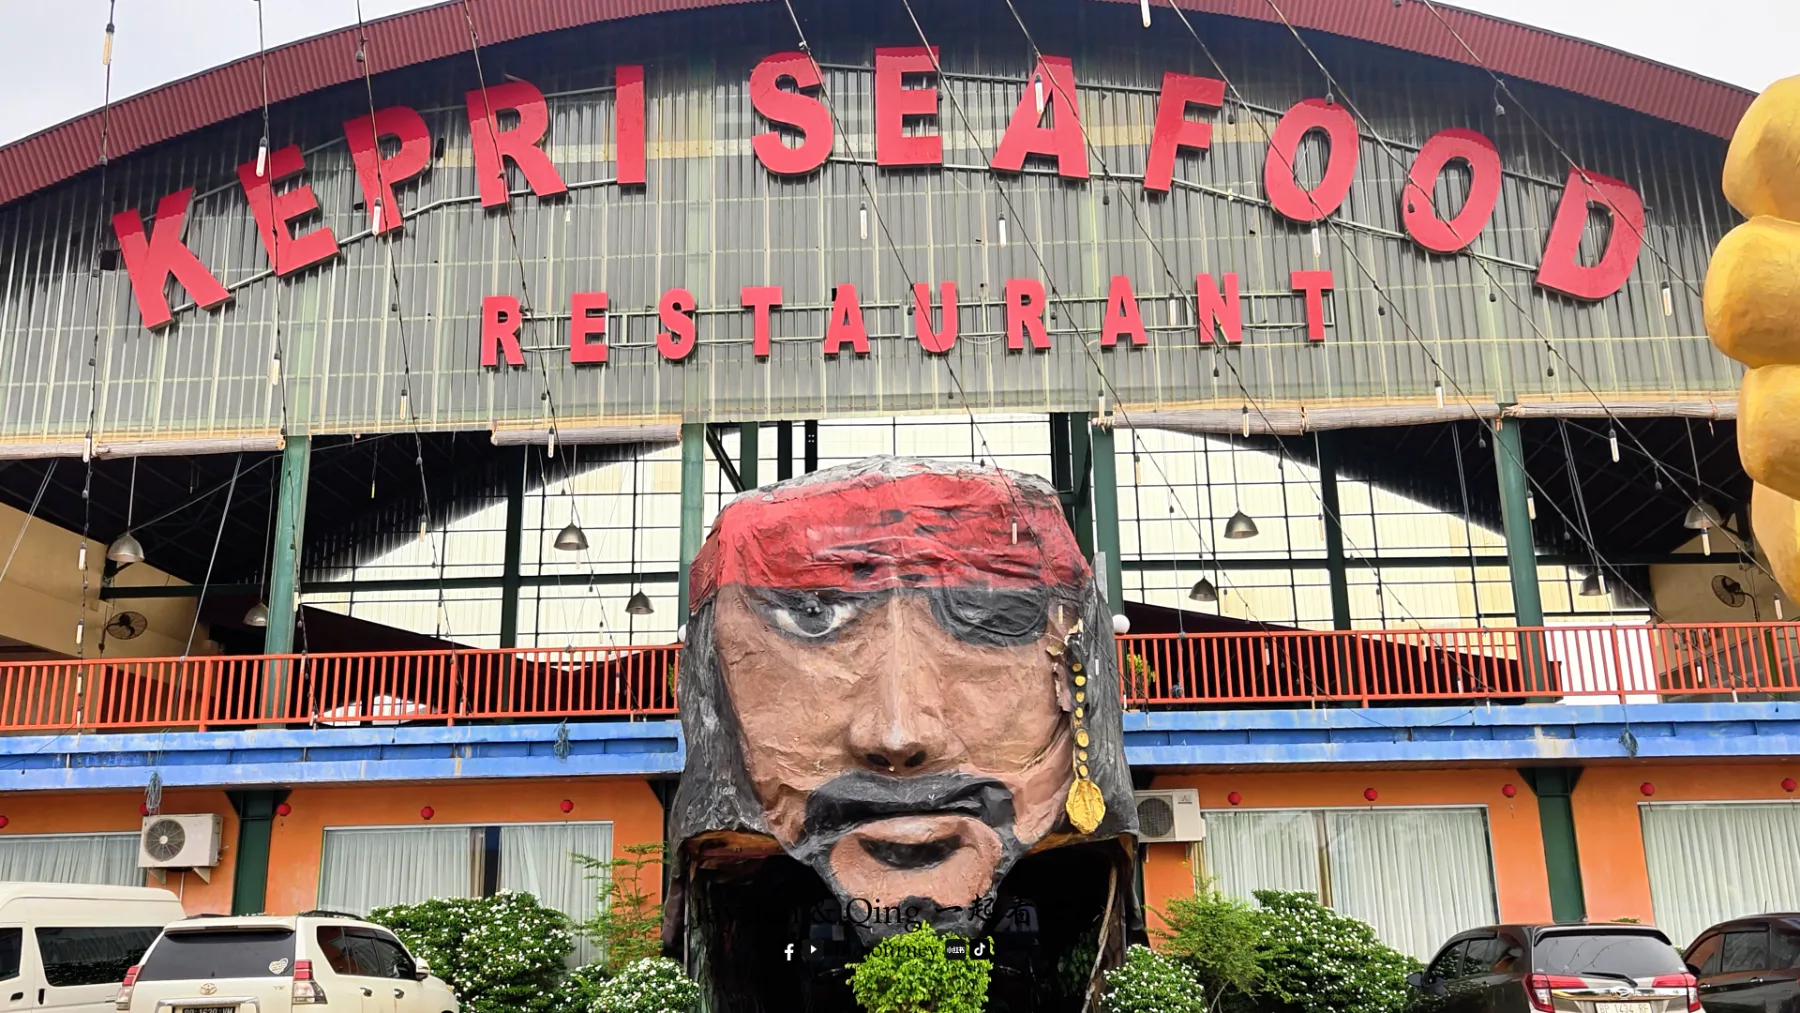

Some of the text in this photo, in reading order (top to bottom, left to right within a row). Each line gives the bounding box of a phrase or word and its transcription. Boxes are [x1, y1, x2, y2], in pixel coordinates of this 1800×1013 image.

[112, 46, 1648, 330] KEPRI SEAFOOD
[481, 271, 1334, 366] RESTAURANT
